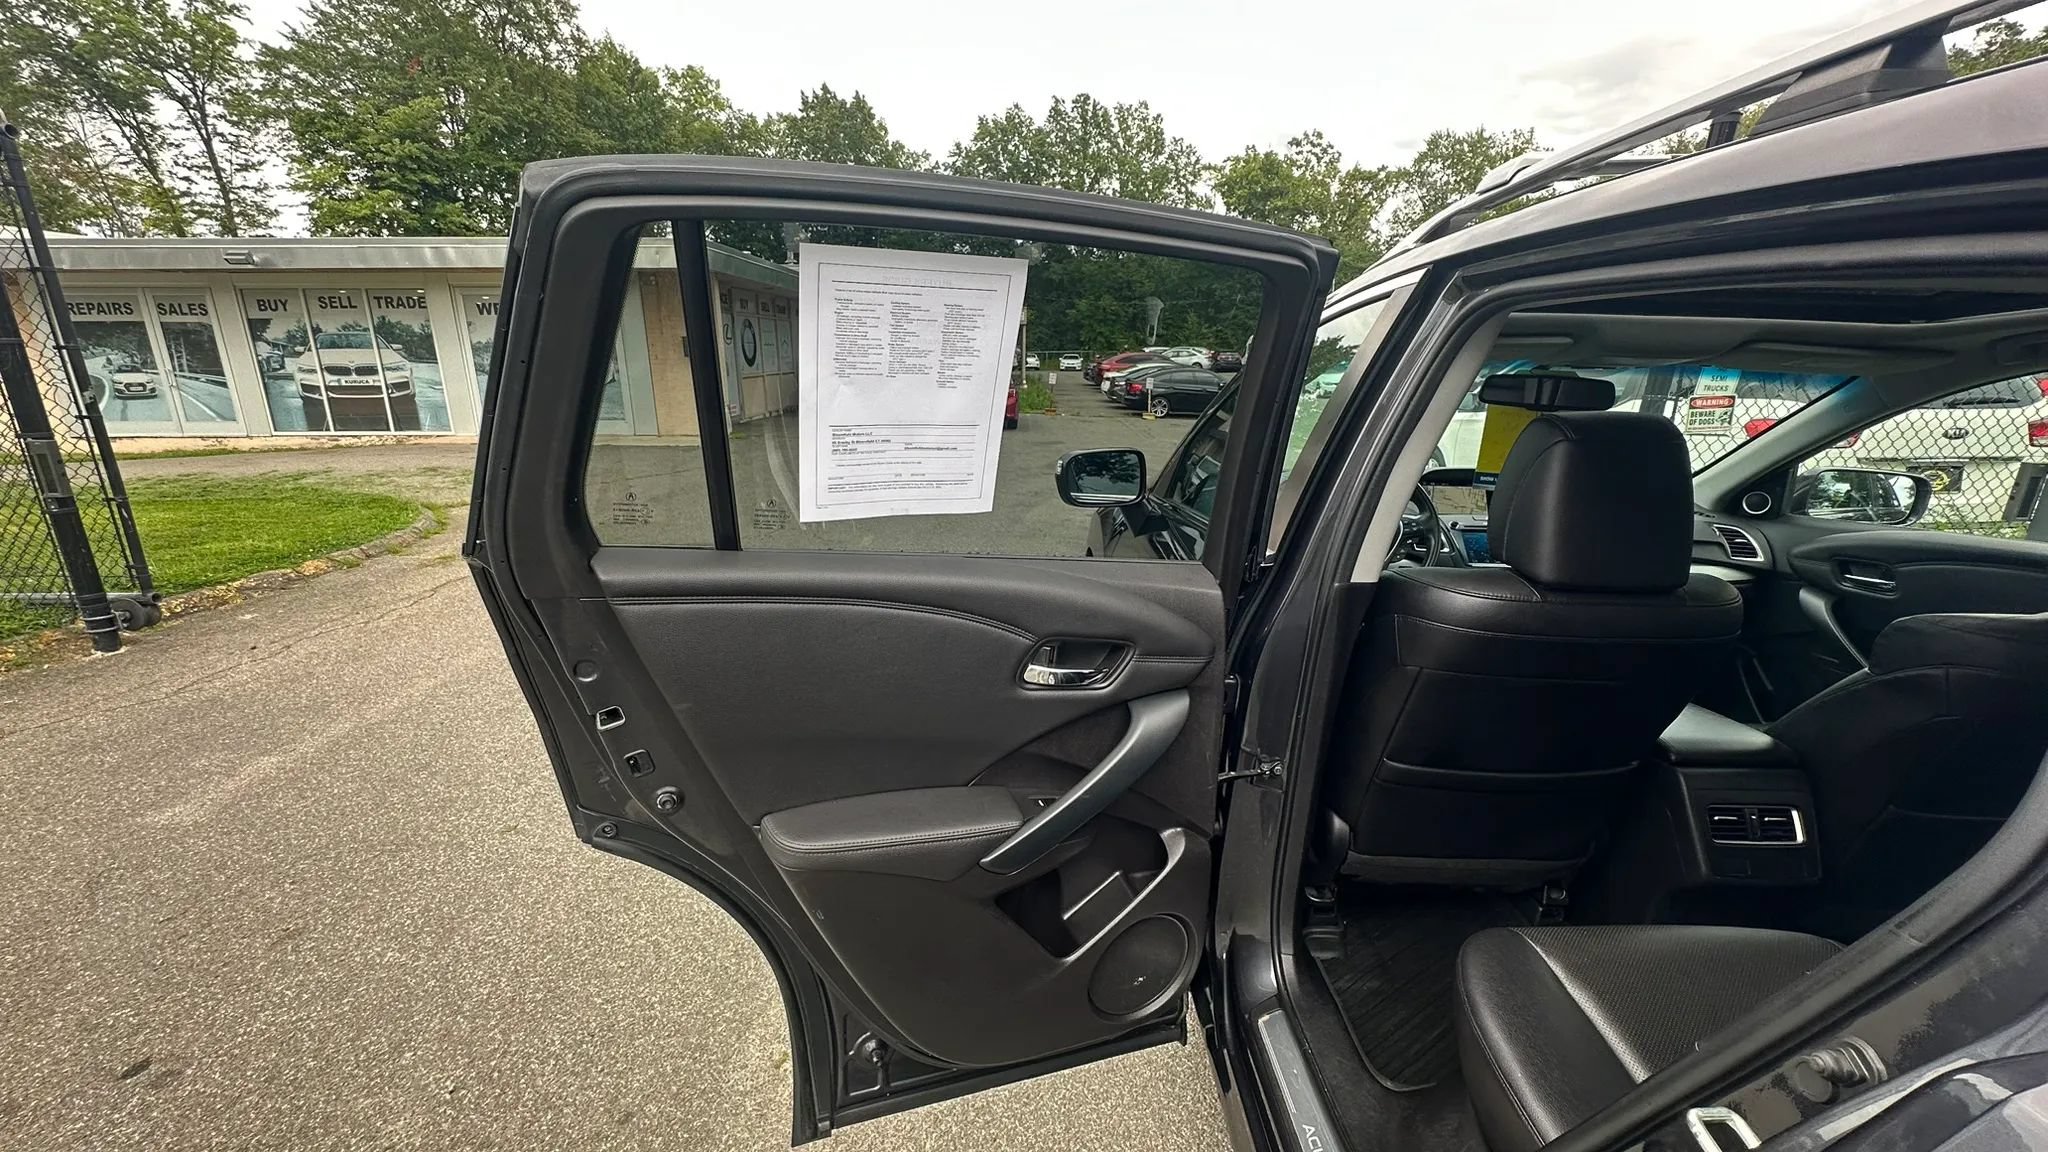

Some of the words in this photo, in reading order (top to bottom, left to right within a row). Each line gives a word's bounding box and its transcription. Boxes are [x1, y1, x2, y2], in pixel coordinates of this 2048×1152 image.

[66, 302, 134, 316] REPAIRS
[157, 302, 209, 316] SALES
[256, 299, 289, 313] BUY
[317, 295, 358, 310] SELL
[373, 295, 428, 310] TRADE
[1947, 428, 1967, 438] KIA
[1302, 1124, 1324, 1152] AC
